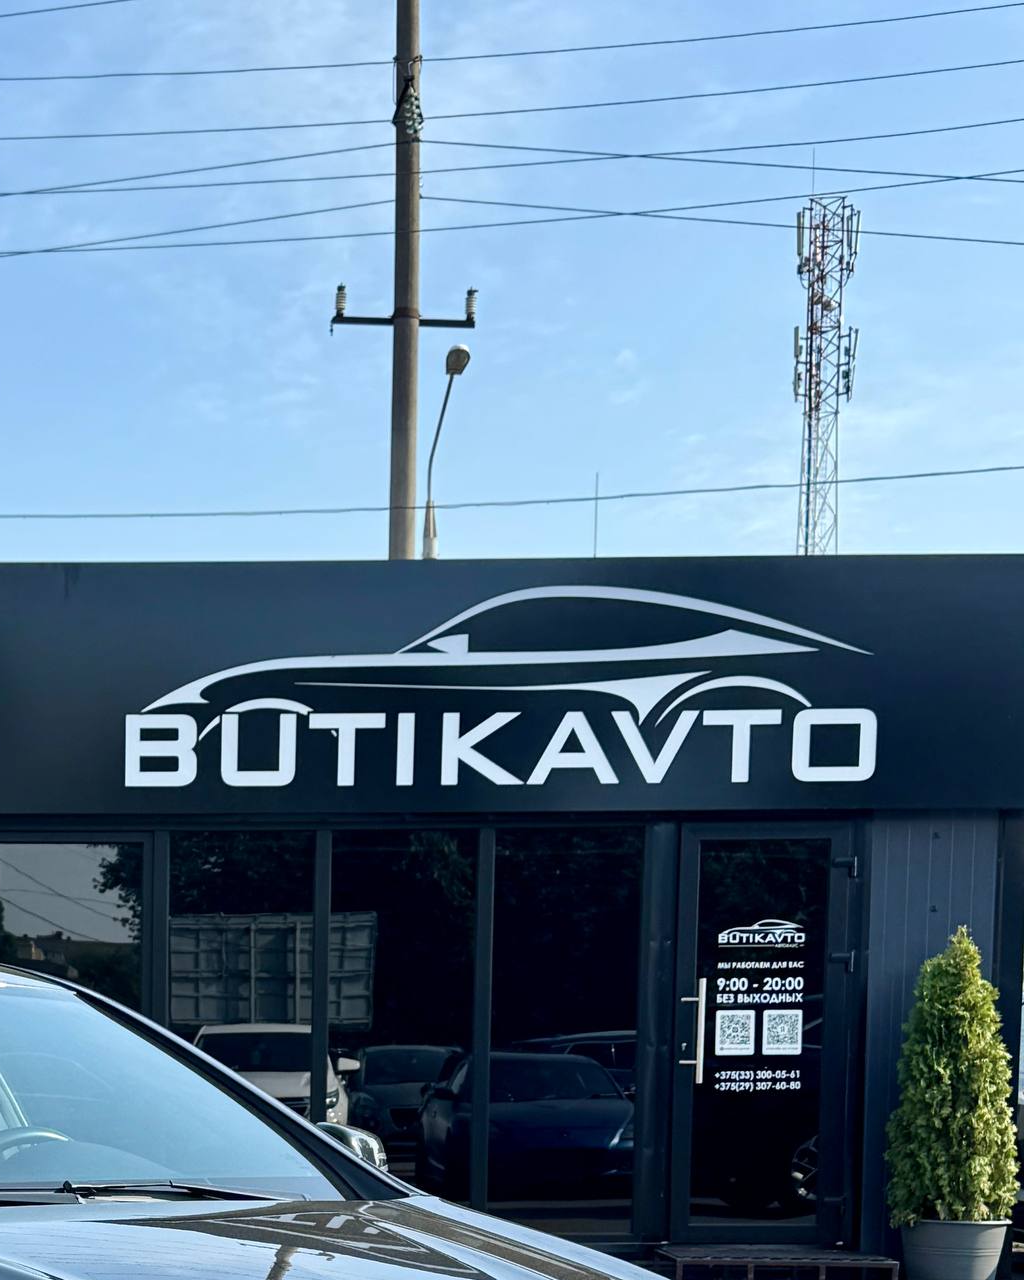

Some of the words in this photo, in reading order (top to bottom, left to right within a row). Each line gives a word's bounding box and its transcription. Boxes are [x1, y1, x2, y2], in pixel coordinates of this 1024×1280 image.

[125, 707, 878, 787] BUTIKAVTO
[718, 933, 805, 943] BUTIKAVTO
[788, 961, 805, 969] ВАС
[717, 978, 748, 991] 9:00
[763, 977, 804, 991] 20:00
[716, 994, 735, 1003] БЕЗ
[737, 993, 804, 1004] ВЫХОДНЫХ
[714, 1071, 754, 1081] +375(33)
[756, 1070, 800, 1079] 300-05-61
[714, 1082, 754, 1092] +375(29)
